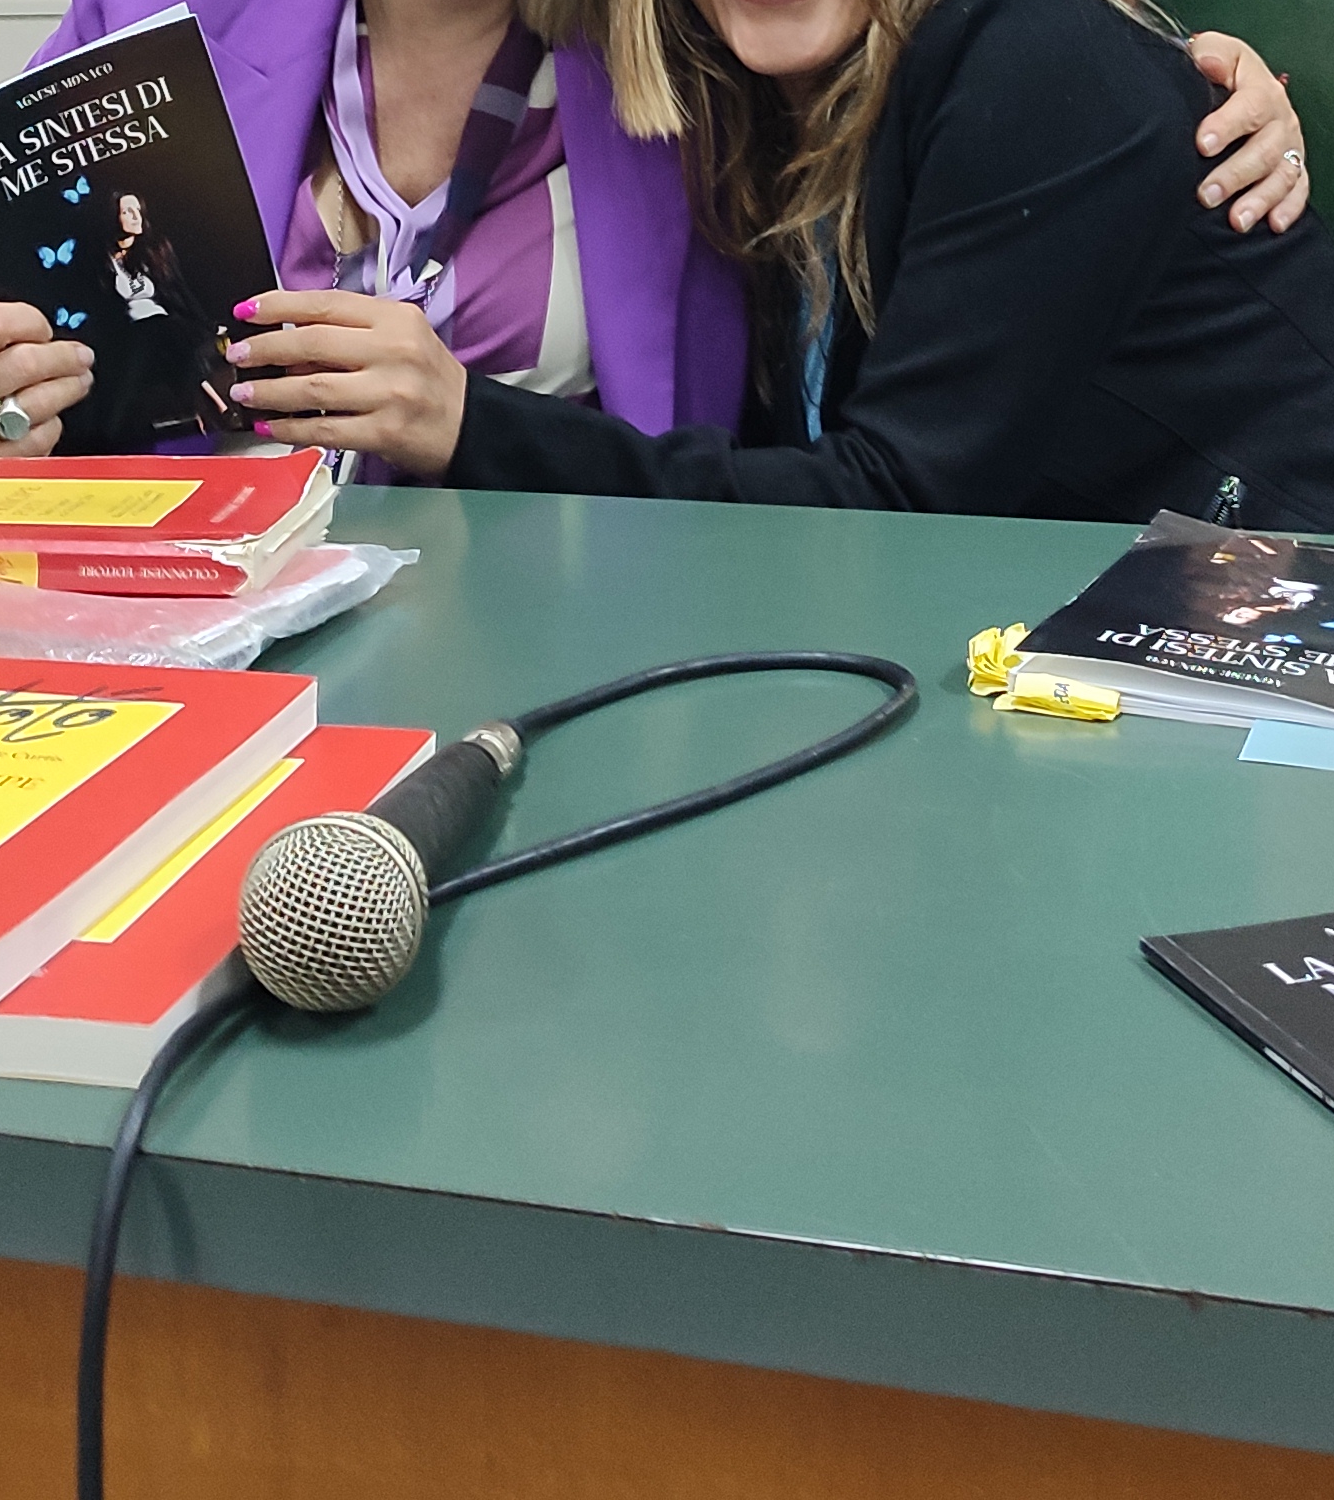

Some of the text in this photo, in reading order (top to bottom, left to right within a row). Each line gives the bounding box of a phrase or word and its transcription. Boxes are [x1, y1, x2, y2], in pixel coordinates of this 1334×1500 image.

[18, 89, 135, 156] SINTESI
[139, 76, 173, 106] DI
[51, 115, 169, 177] STESSA
[79, 565, 219, 581] COLONNESE EDITORE
[1096, 629, 1149, 648] DI
[1138, 623, 1291, 658] STESSA
[1149, 636, 1311, 677] SINTESI
